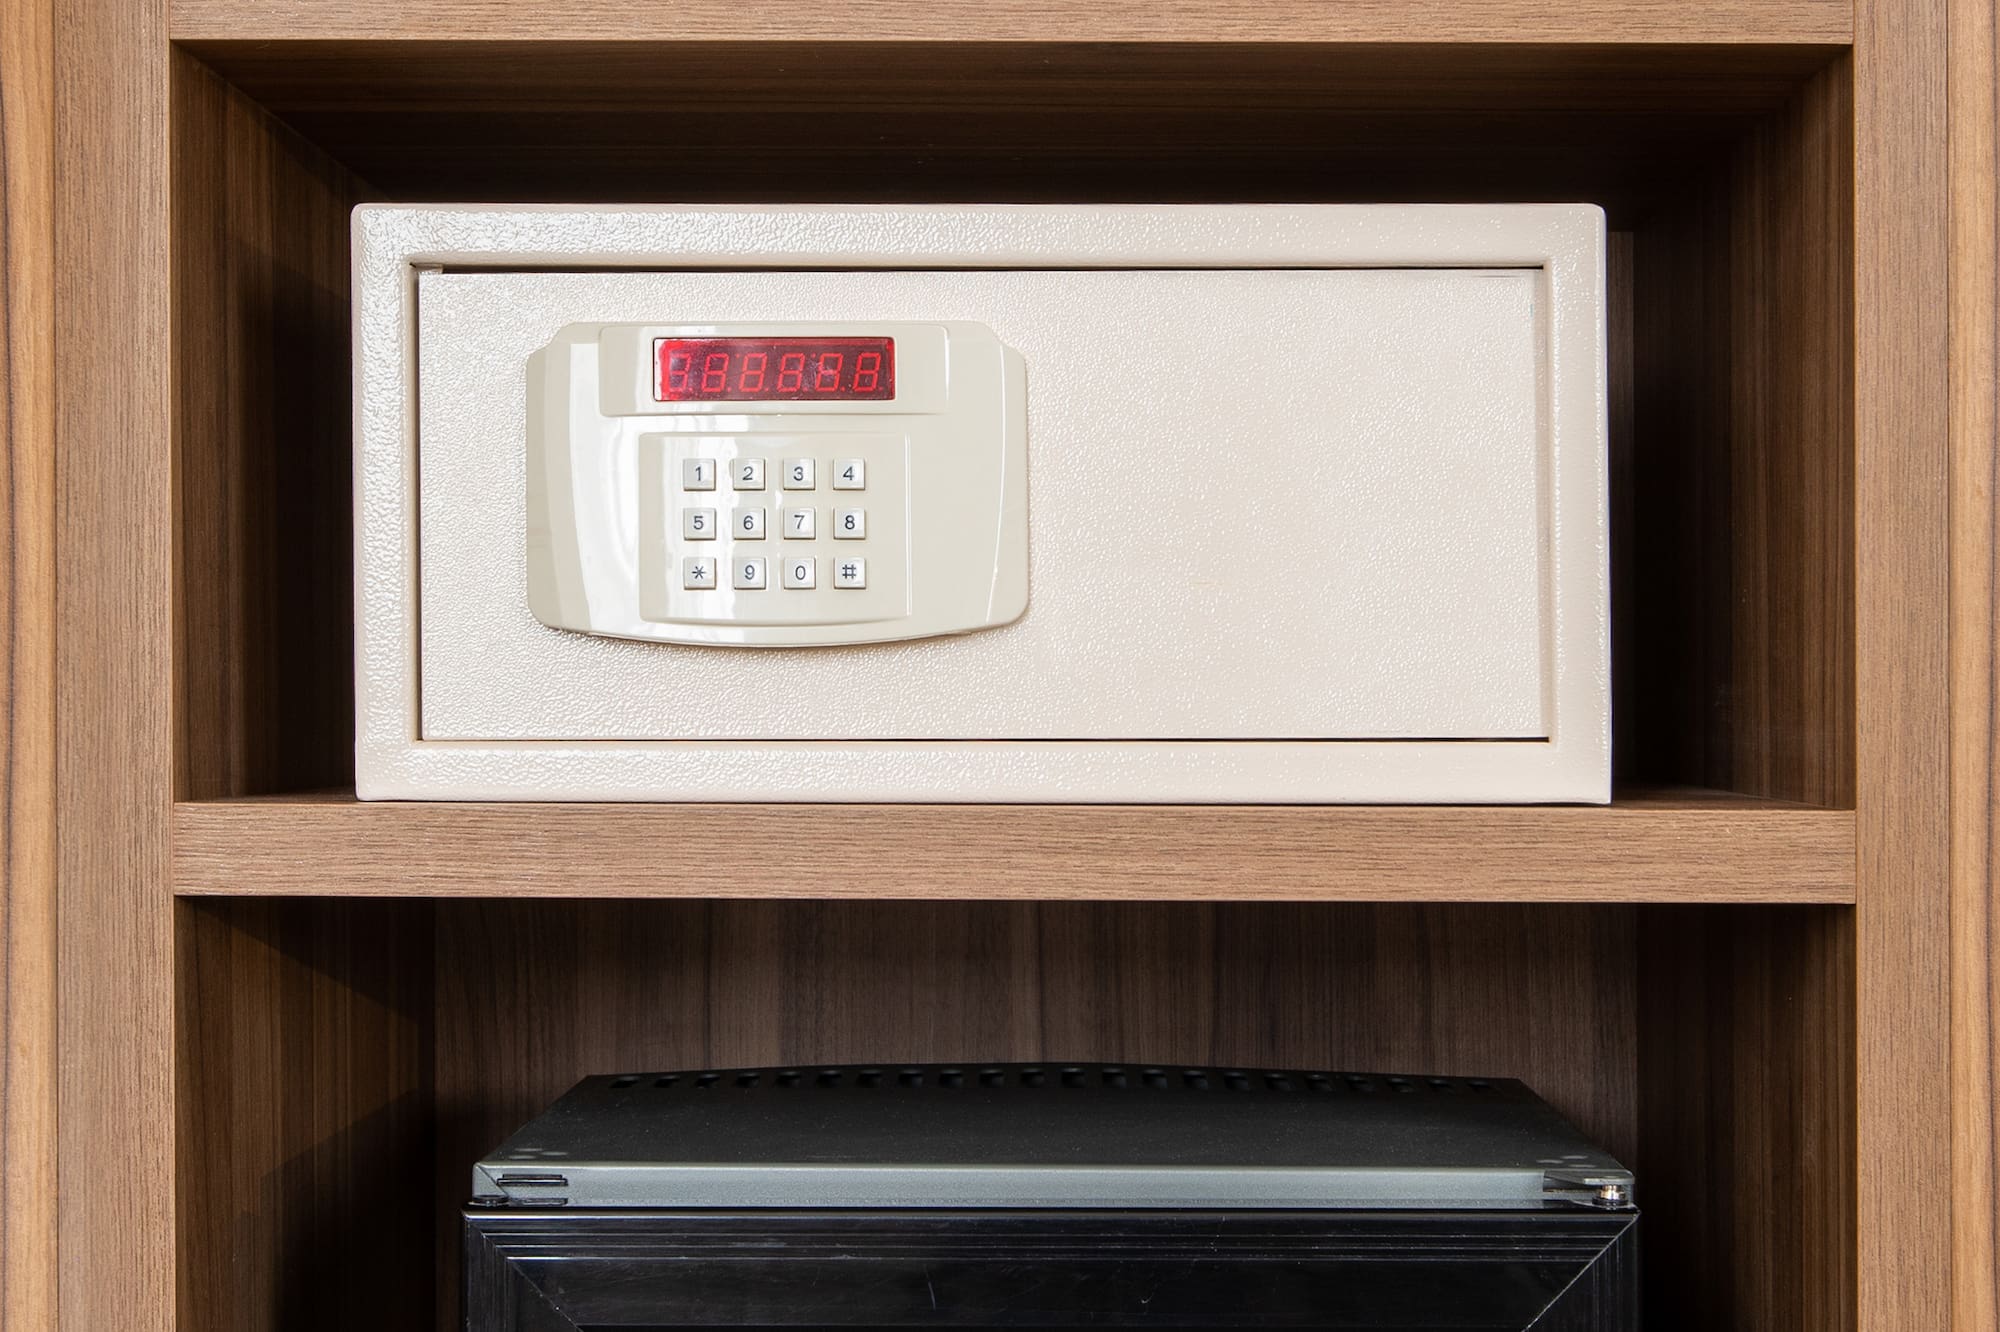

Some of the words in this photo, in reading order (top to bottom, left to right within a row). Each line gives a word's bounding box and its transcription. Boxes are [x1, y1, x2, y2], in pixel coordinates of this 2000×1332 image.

[694, 465, 703, 482] 1
[741, 466, 753, 481] 2
[792, 466, 804, 482] 3
[841, 466, 854, 481] 4
[692, 515, 704, 530] 5
[742, 515, 754, 531] 6
[793, 514, 805, 529] 7
[843, 514, 856, 530] 8
[743, 564, 755, 581] 9
[794, 565, 806, 581] 0
